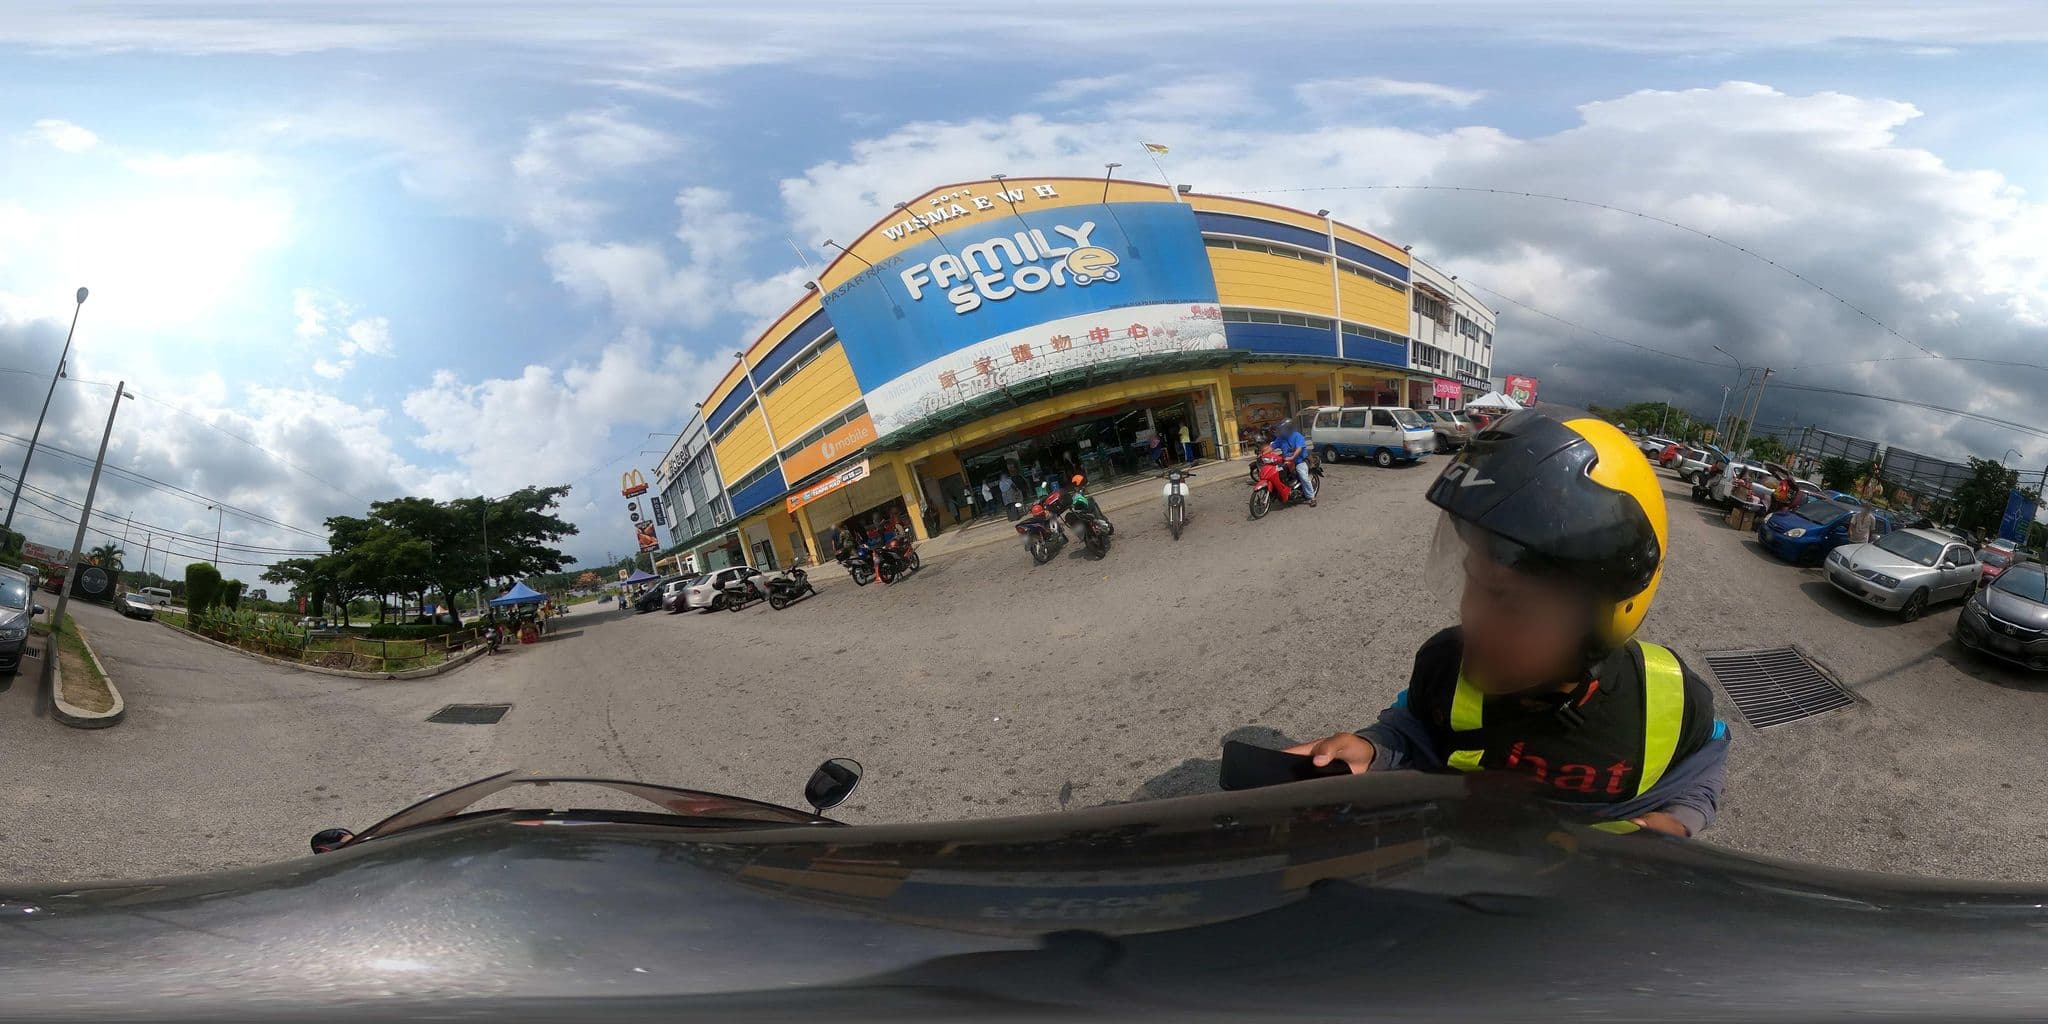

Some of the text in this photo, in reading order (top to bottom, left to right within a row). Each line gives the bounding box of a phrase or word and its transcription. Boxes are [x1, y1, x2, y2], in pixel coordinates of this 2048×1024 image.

[930, 189, 972, 206] 2011
[882, 203, 970, 241] WISMA
[900, 221, 1096, 300] FAMILY
[823, 255, 903, 305] PASAR RAYA
[835, 427, 869, 451] mobile
